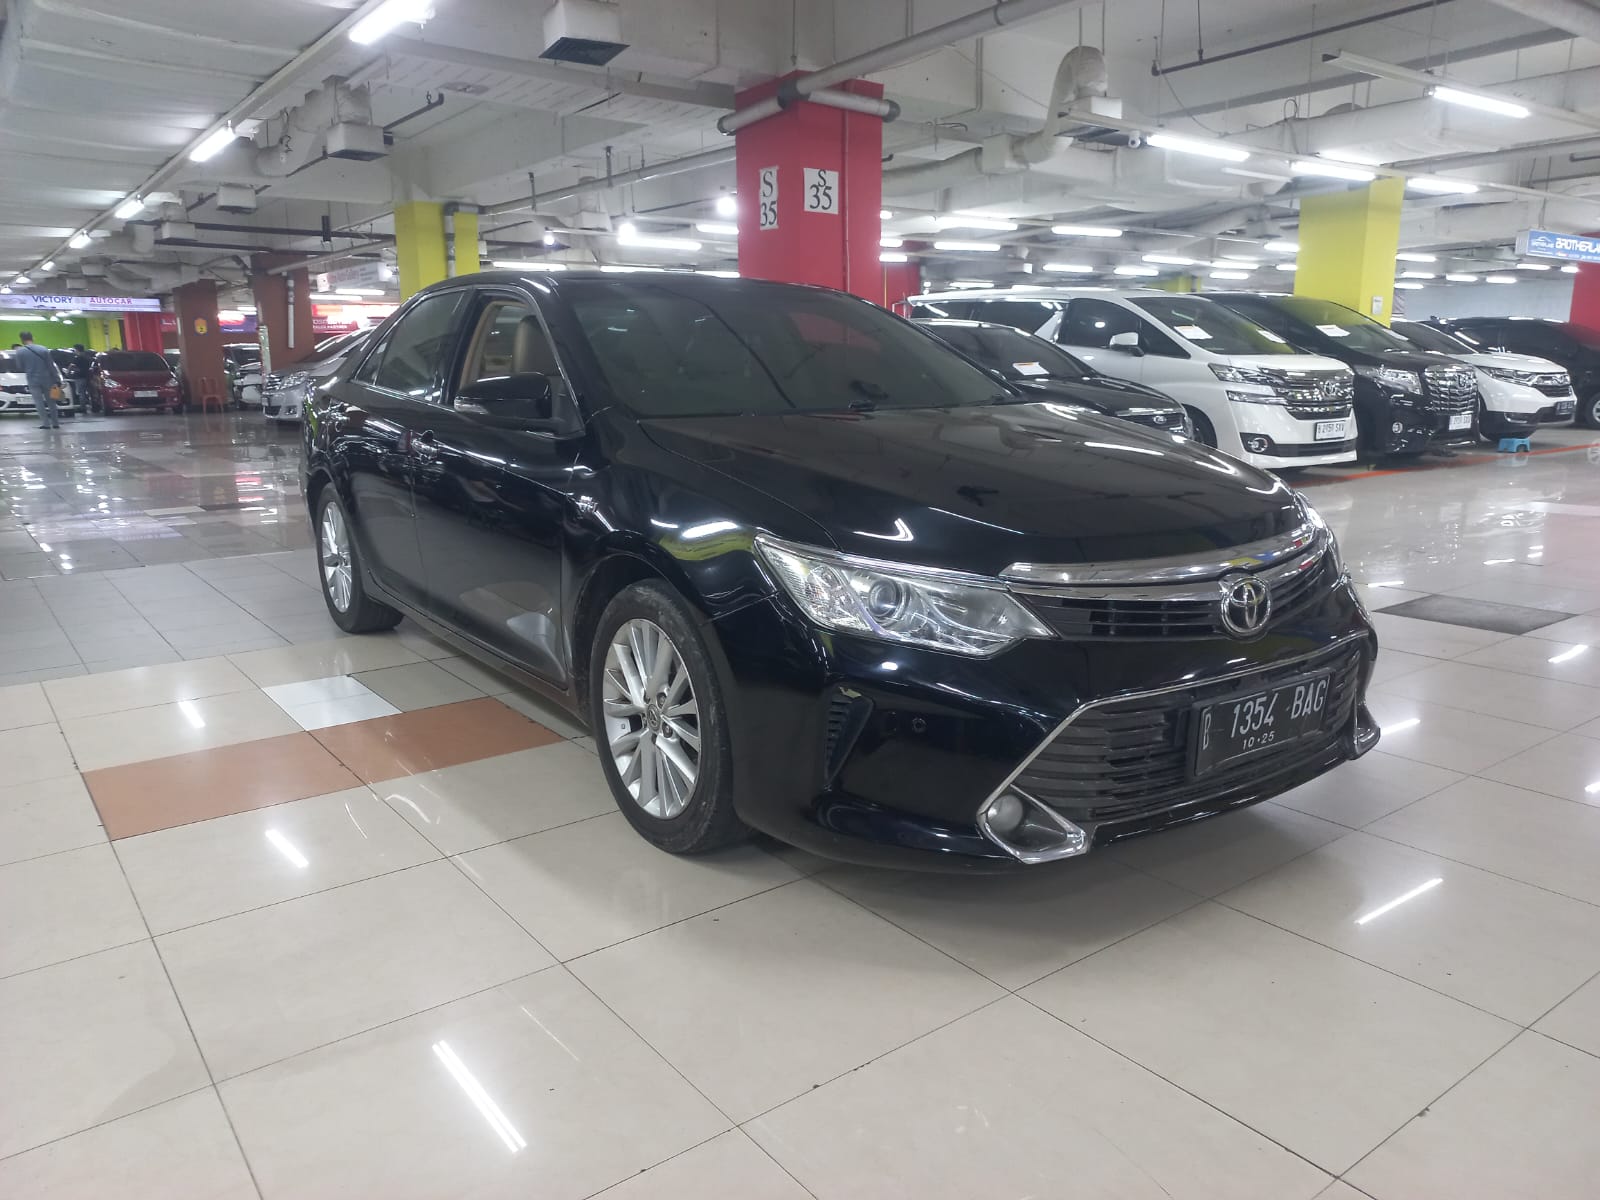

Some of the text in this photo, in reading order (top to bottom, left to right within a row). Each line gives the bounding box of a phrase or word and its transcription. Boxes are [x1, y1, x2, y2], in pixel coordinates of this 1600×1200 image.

[762, 171, 773, 198] S
[818, 169, 827, 188] S
[809, 184, 832, 210] 35
[760, 201, 777, 226] 35
[32, 295, 73, 304] VICTORY
[90, 296, 133, 305] AUTOCAR
[1203, 680, 1326, 750] B 1354 BAG
